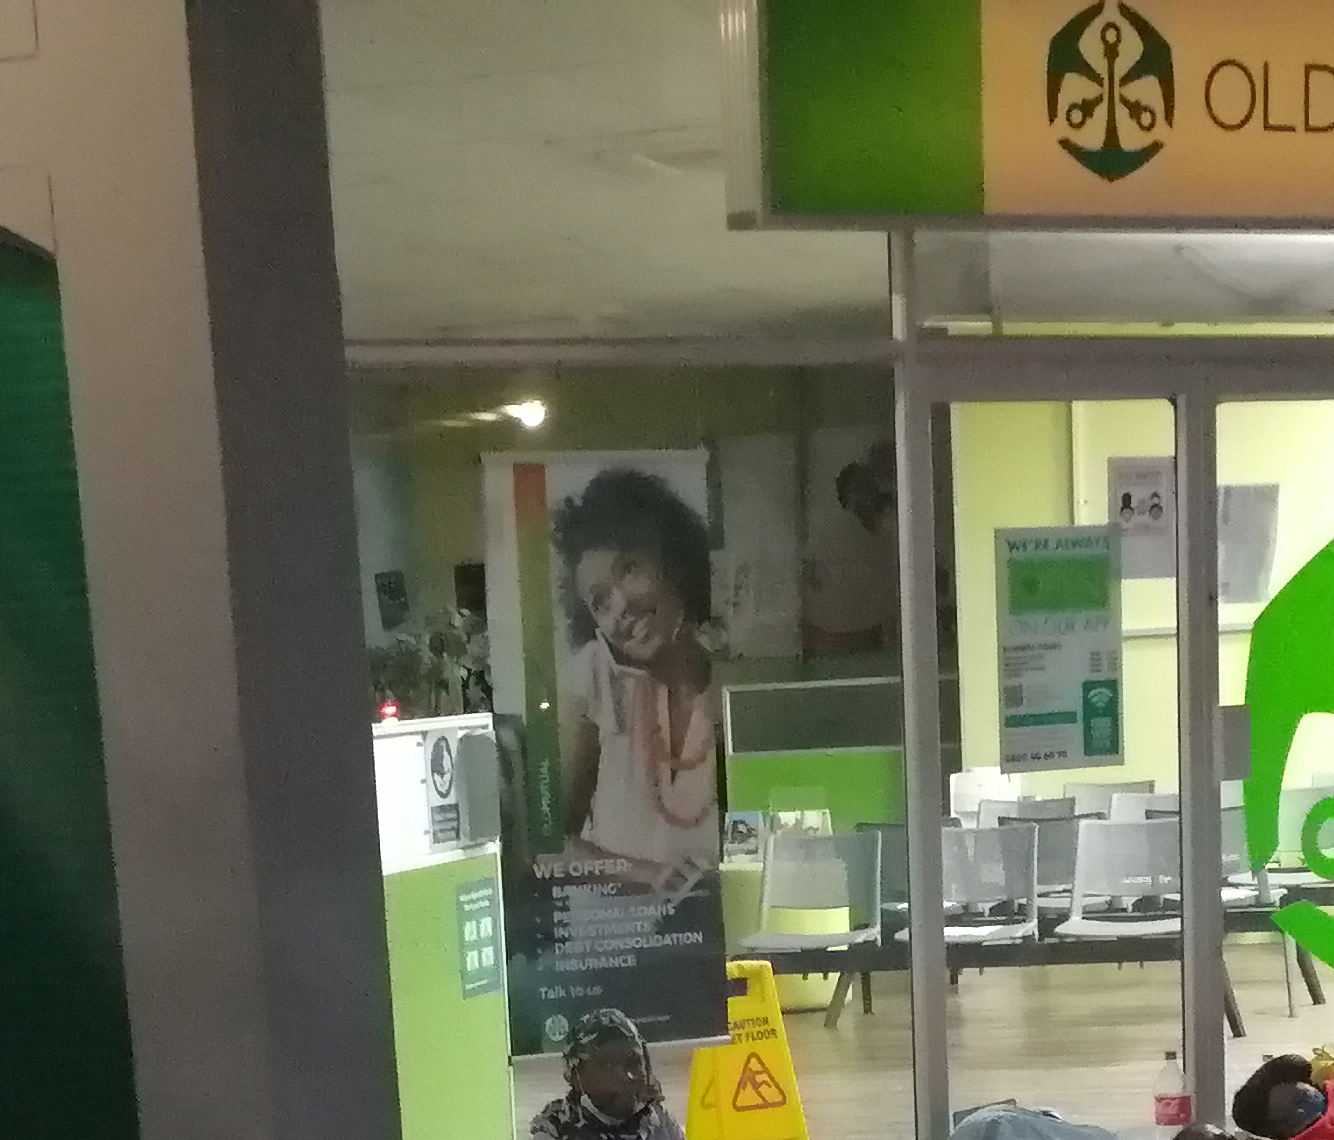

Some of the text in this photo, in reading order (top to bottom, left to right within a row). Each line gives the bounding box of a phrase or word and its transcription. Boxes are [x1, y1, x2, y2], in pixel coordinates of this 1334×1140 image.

[532, 861, 567, 880] WE
[554, 920, 653, 940] INVESTMENTS
[554, 930, 704, 956] DEBT CONSOLIDATION
[555, 955, 639, 973] INSURANCE
[539, 985, 568, 1000] Talk
[570, 985, 585, 998] to
[727, 1016, 770, 1032] CAUTION
[745, 1027, 779, 1043] FLOOR
